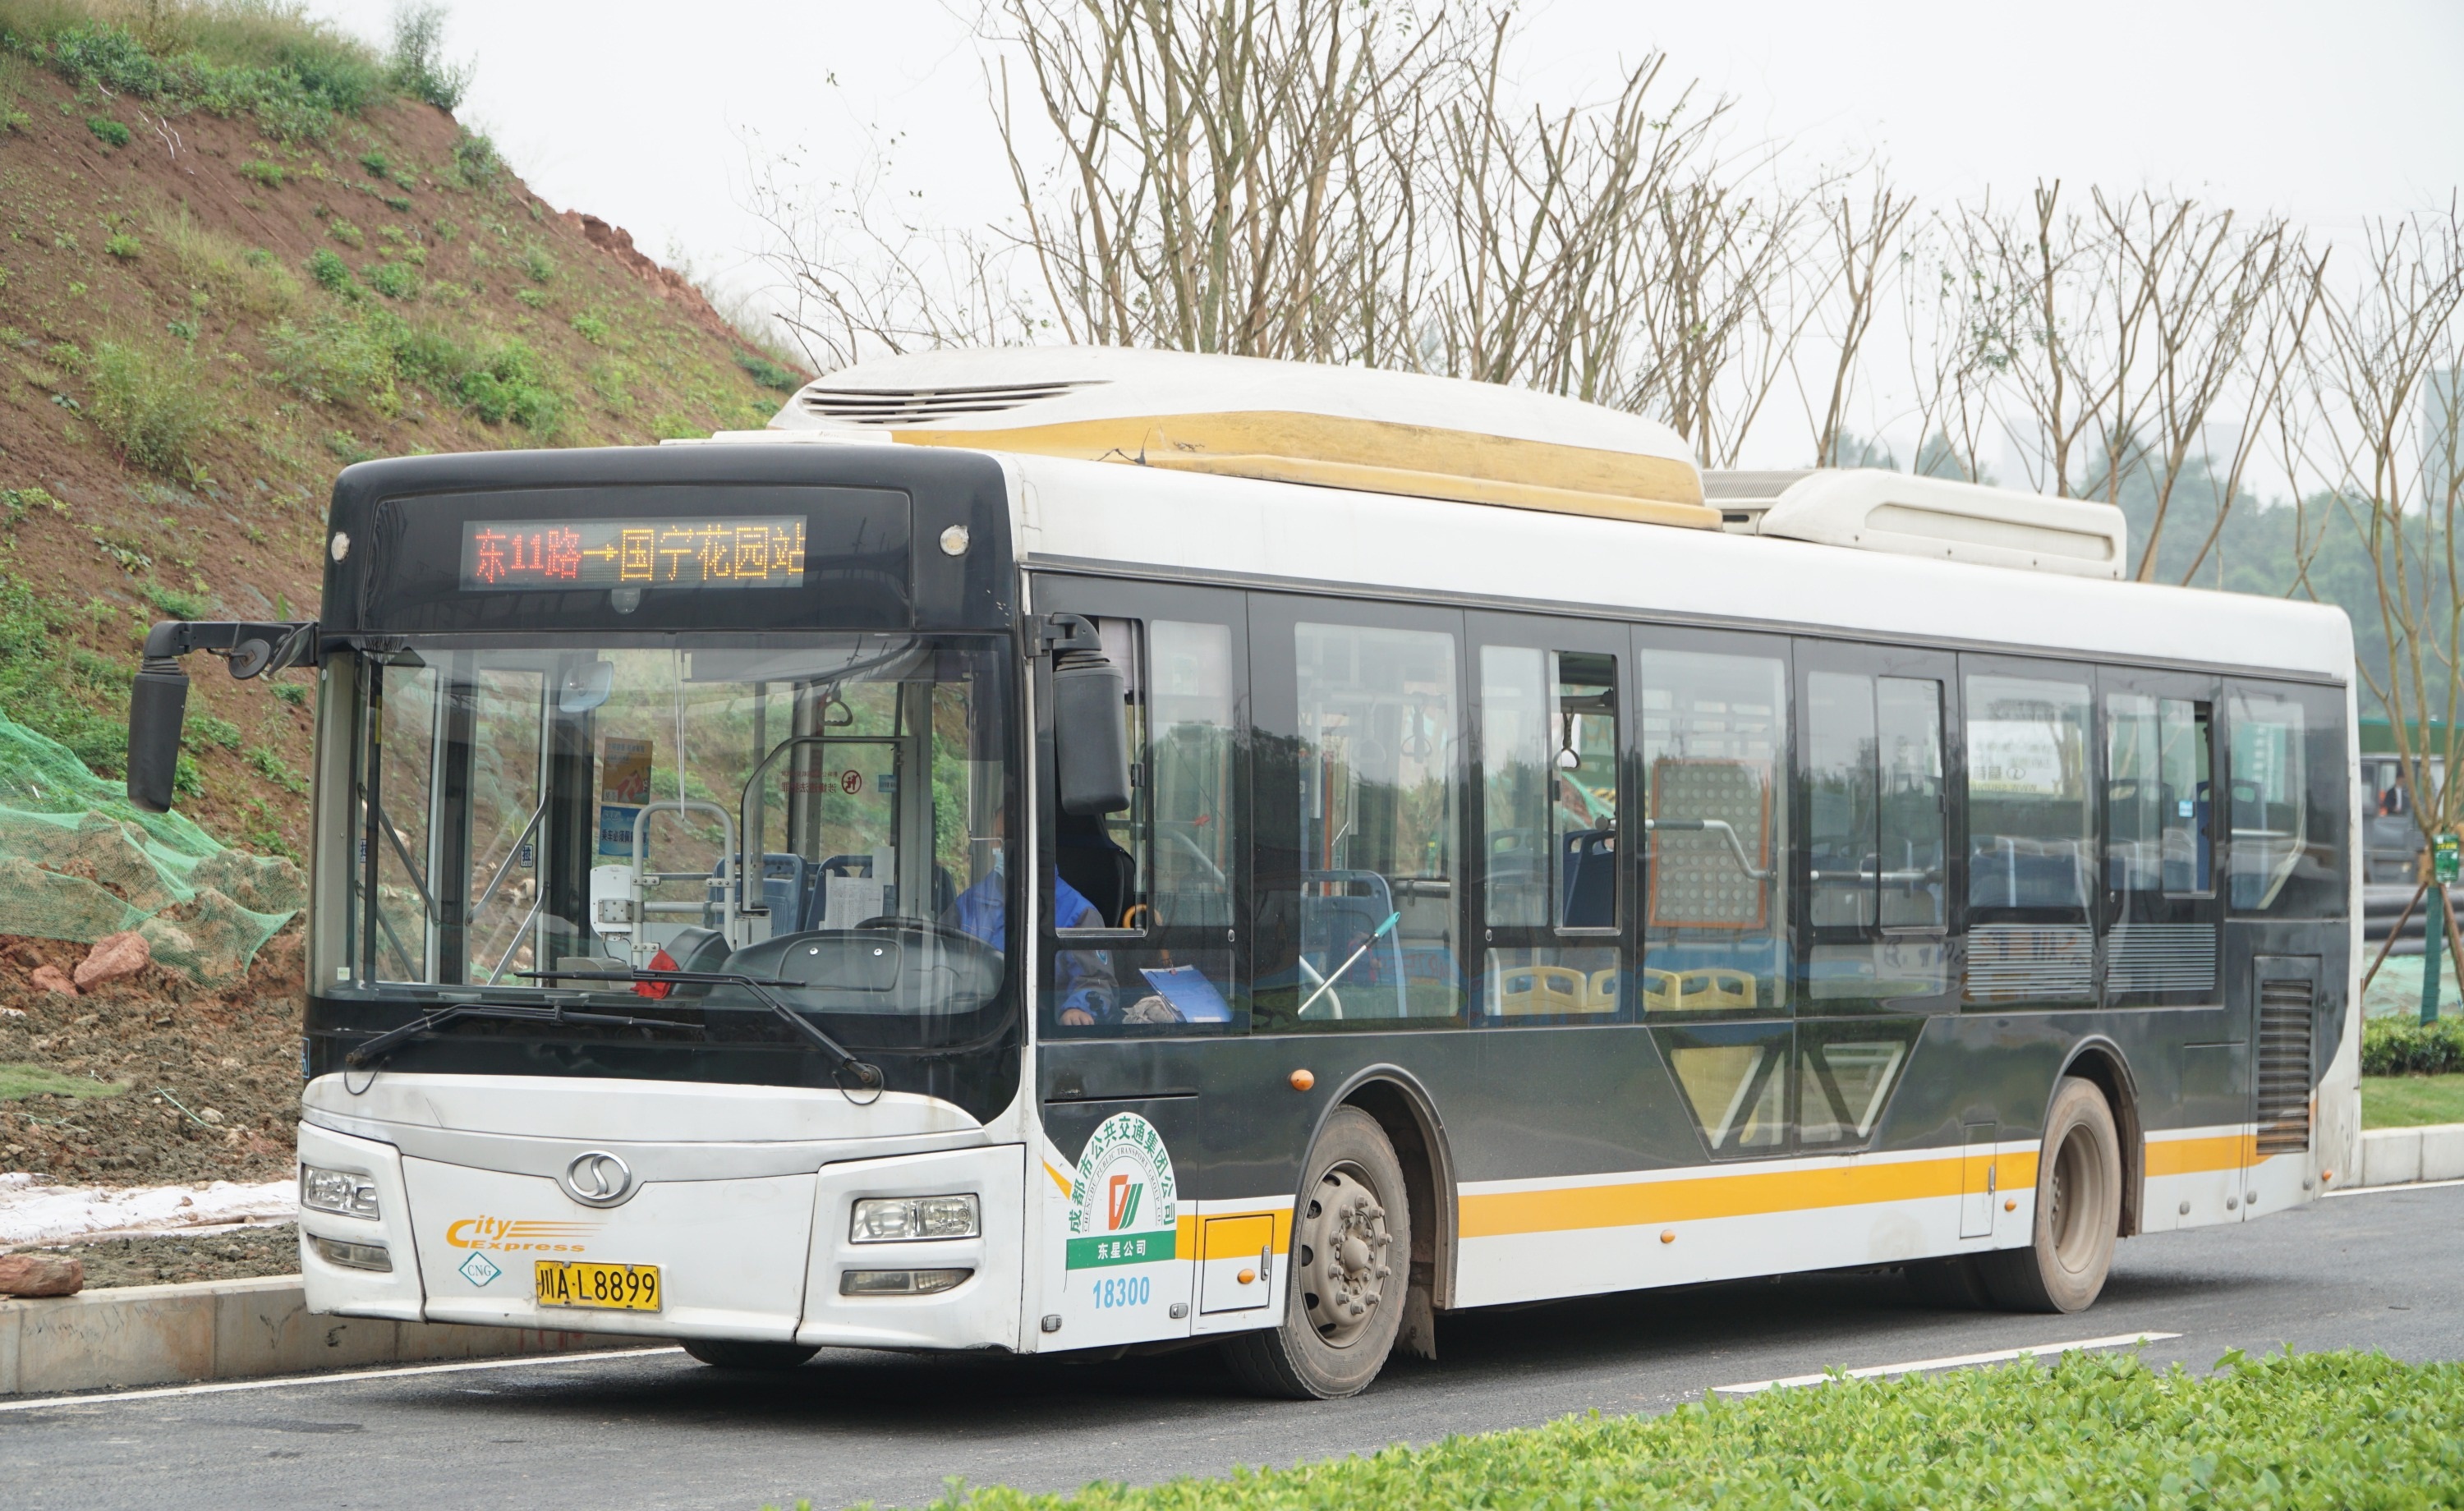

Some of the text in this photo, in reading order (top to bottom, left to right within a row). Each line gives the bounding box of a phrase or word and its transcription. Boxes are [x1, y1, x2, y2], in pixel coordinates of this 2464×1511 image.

[476, 522, 805, 583] 东11路 国宁花园站
[1069, 1115, 1175, 1233] 成都市公共交通集团公司
[1084, 1179, 1097, 1232] CHENGDU
[1096, 1151, 1115, 1178] PUBLIC
[1117, 1146, 1149, 1168] TRANSPORT
[1148, 1169, 1160, 1202] GROUP
[446, 1215, 513, 1248] City
[470, 1239, 586, 1252] Express
[1097, 1239, 1147, 1261] 东星公司
[467, 1265, 491, 1277] CNG
[1092, 1276, 1150, 1309] 18300
